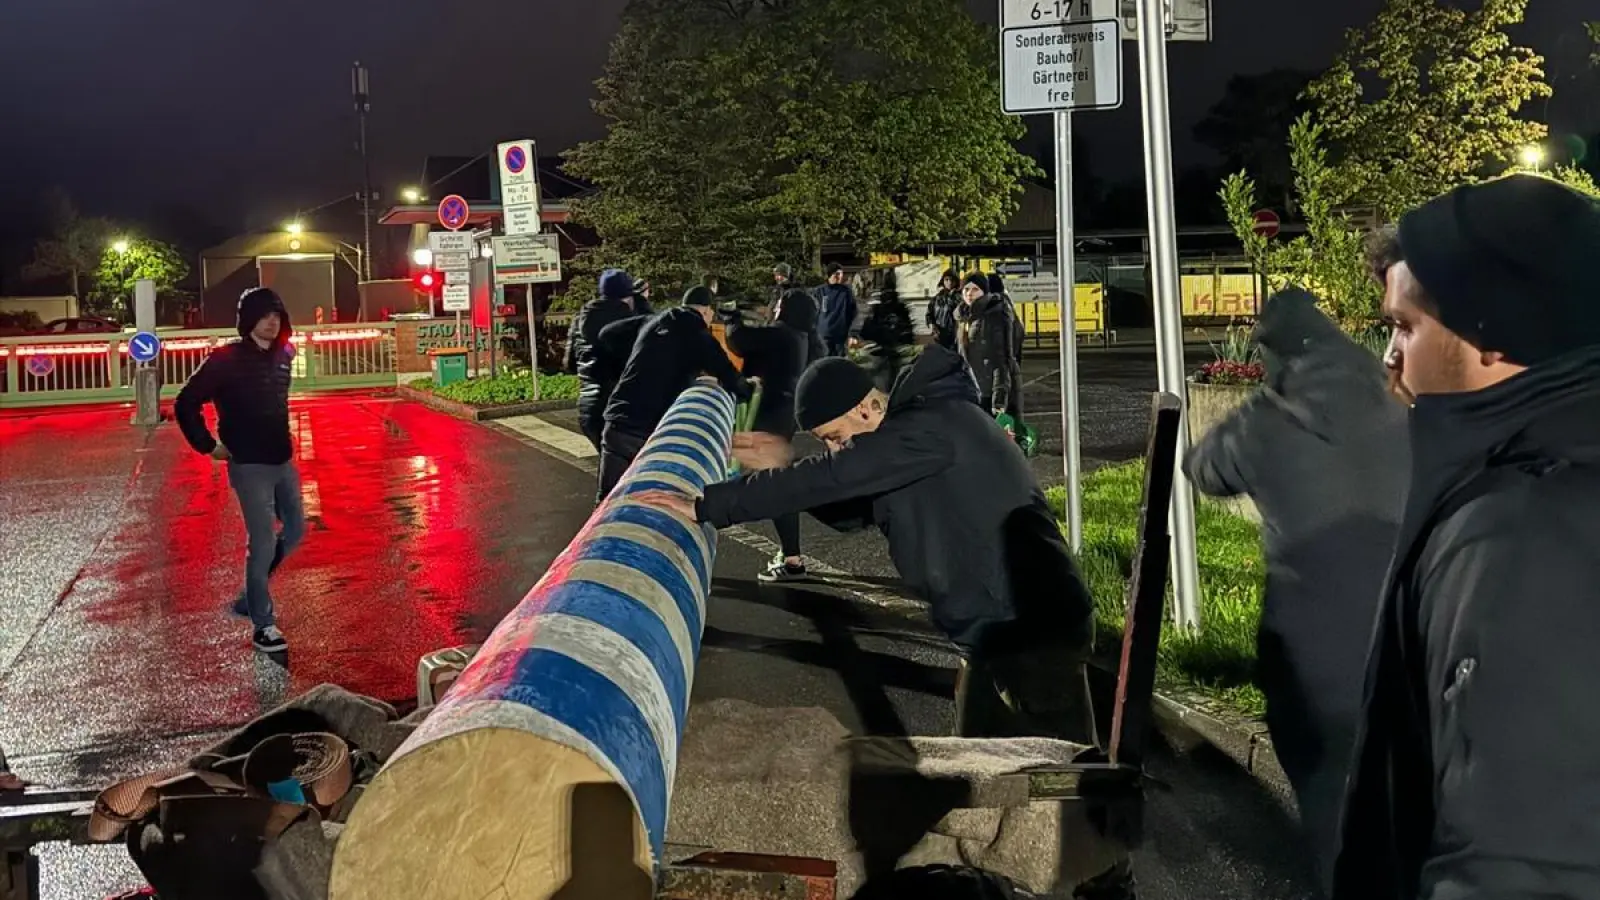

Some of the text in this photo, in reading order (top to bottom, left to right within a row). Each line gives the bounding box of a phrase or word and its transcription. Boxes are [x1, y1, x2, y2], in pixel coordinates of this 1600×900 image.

[1030, 0, 1073, 20] 6-17
[1015, 28, 1105, 48] Sonderausweis
[1036, 48, 1083, 65] Bauhof/
[1033, 67, 1089, 85] Gärtnerei
[1047, 88, 1075, 102] frei
